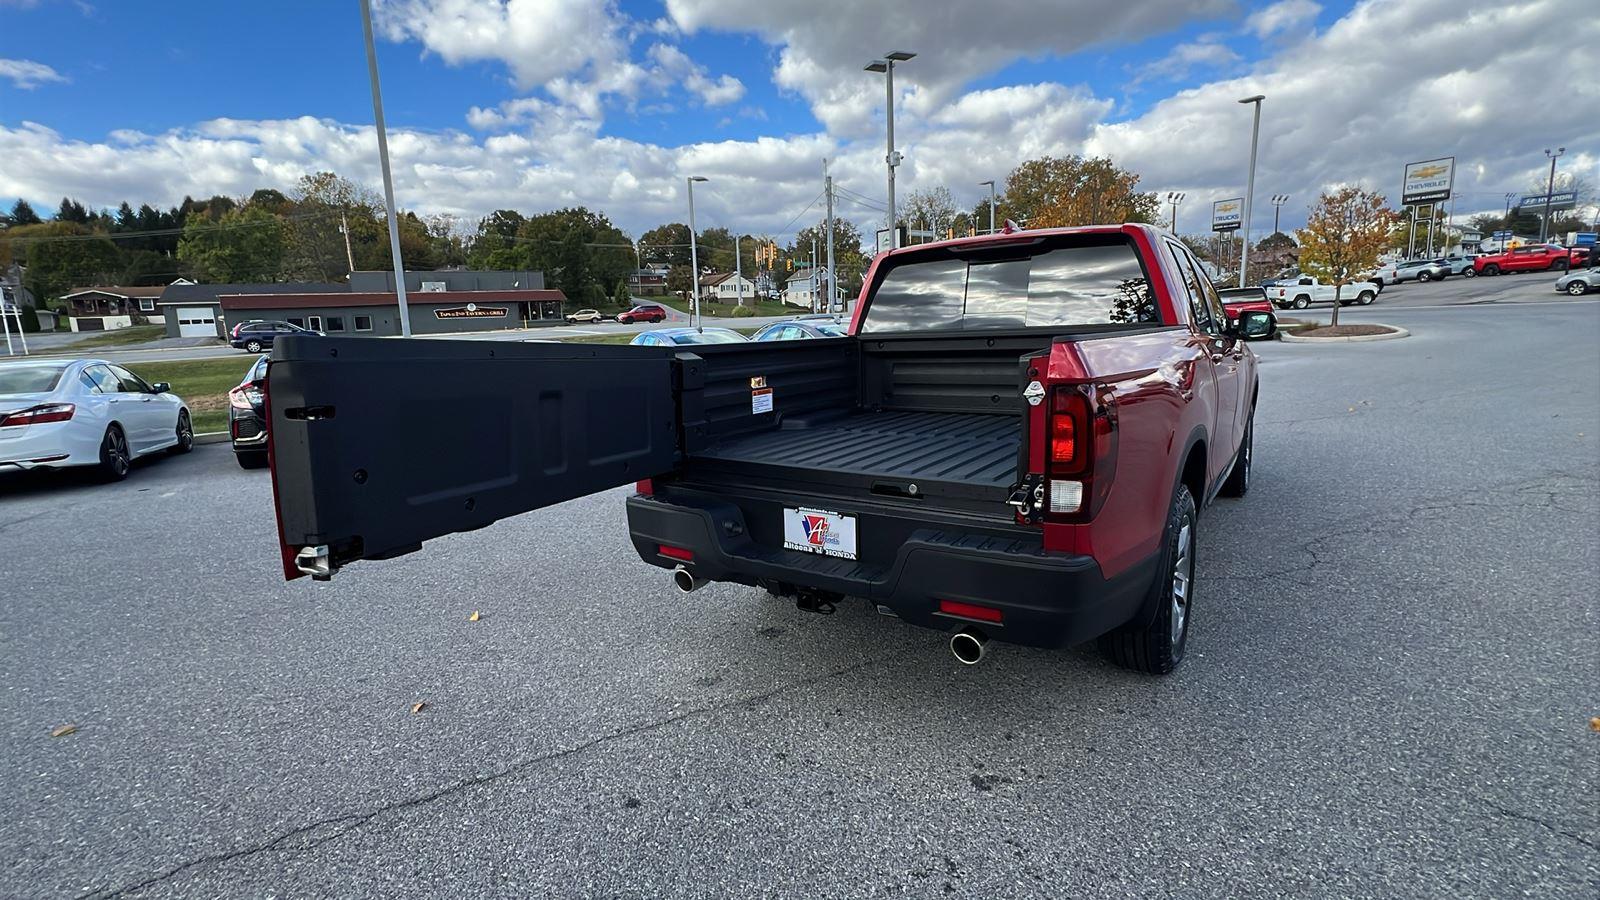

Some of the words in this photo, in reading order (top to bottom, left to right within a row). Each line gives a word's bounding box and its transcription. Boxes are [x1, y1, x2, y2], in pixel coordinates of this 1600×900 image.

[1407, 180, 1447, 190] CHEVROLET
[1215, 213, 1240, 221] TRUCKS
[784, 541, 813, 552] Altoona
[825, 549, 856, 560] HONDA
